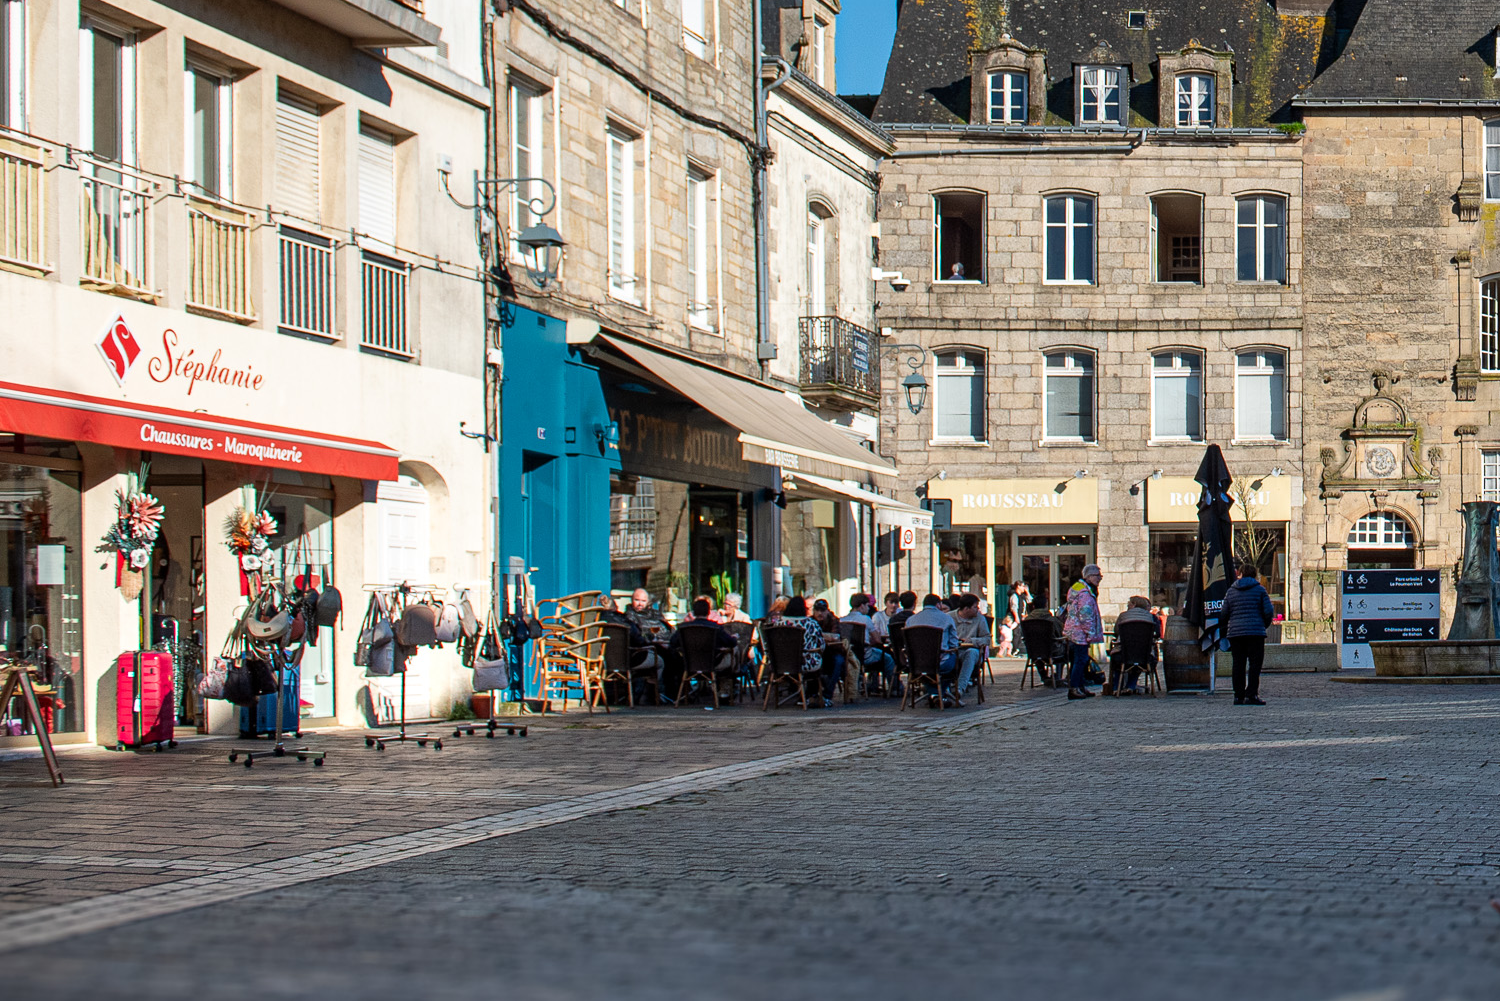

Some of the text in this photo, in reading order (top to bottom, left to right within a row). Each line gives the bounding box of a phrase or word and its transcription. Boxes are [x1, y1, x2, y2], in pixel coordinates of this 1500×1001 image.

[148, 328, 264, 395] Stéphanie
[140, 423, 214, 451] Chaussures
[225, 436, 303, 464] Maroquinerie
[962, 493, 1064, 509] ROUSSEAU
[1169, 490, 1271, 507] ROAU
